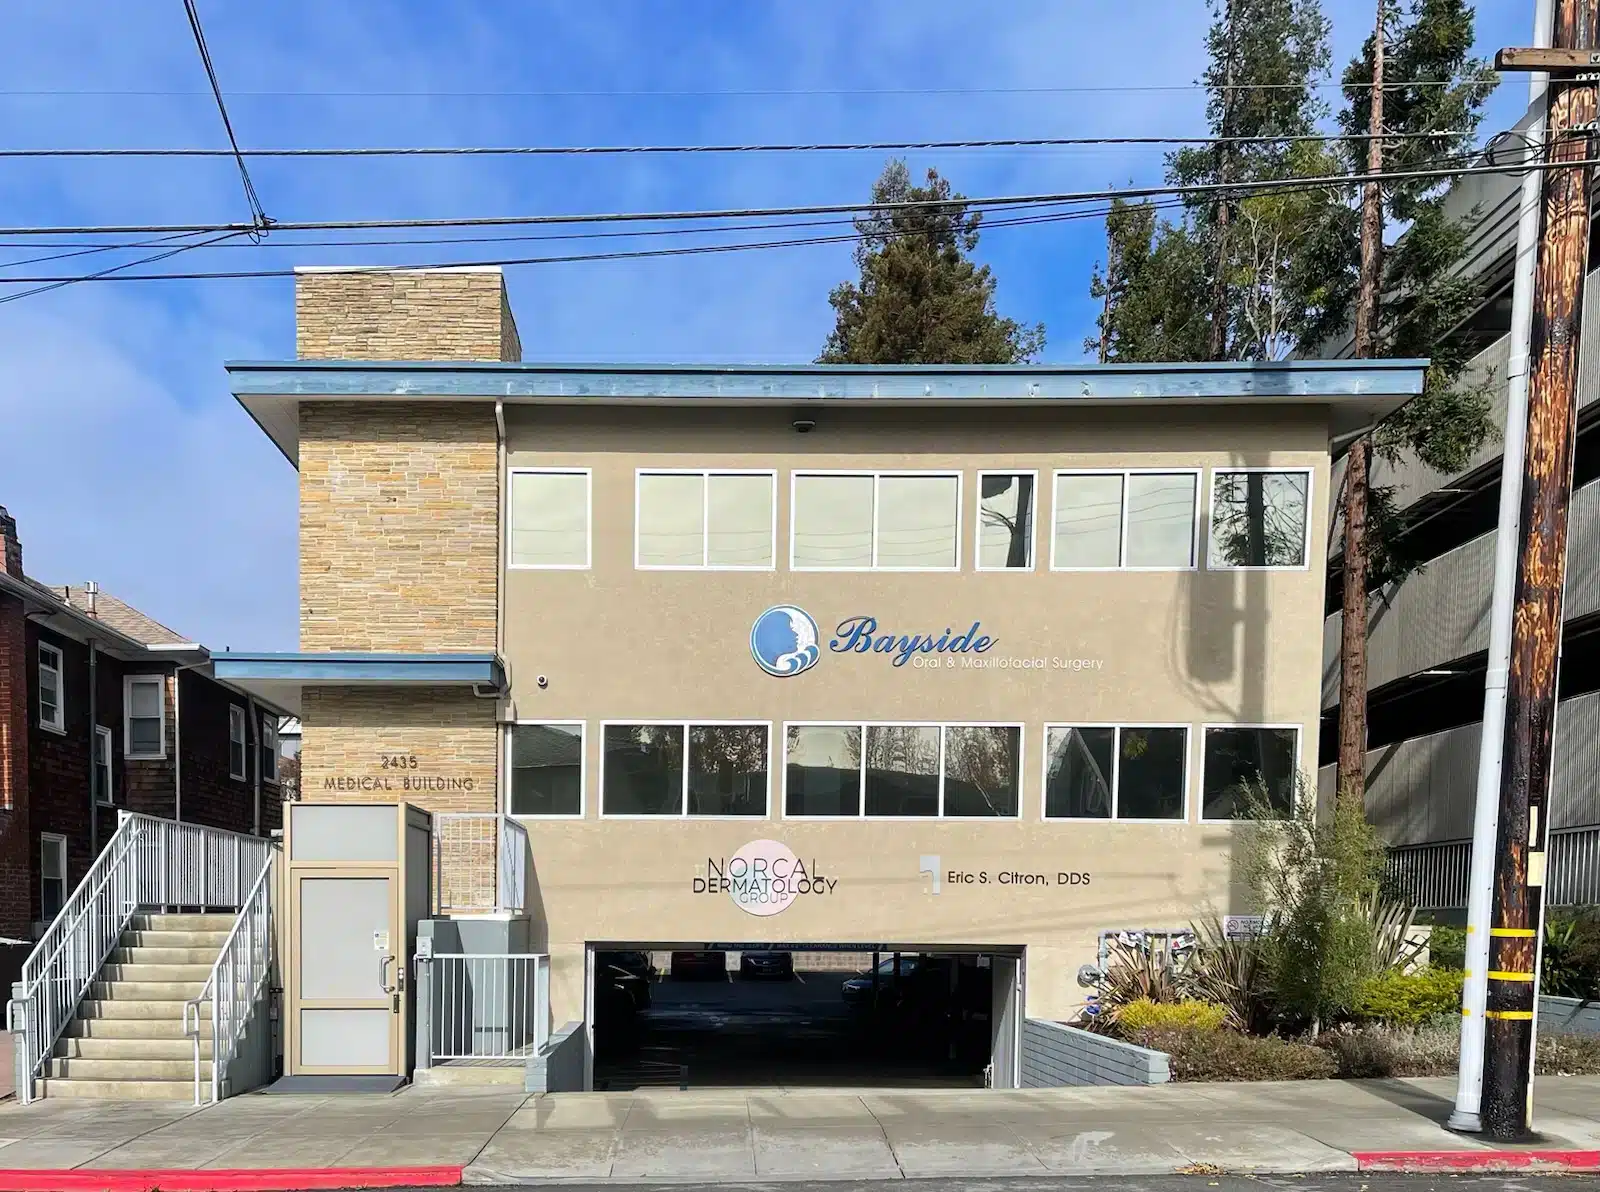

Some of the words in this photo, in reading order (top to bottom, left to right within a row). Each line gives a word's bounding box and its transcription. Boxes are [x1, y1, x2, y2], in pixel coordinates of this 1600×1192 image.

[829, 615, 999, 668] Bayside
[912, 655, 942, 669] Oral
[945, 656, 956, 669] &
[961, 655, 1048, 669] Maxillofacial
[1052, 656, 1104, 672] Surgery
[380, 755, 418, 770] 2435
[323, 776, 393, 791] MEDICAL
[403, 776, 474, 791] BUILDING
[707, 857, 825, 880] NORCAL
[692, 877, 838, 895] DERMATOLOGY
[947, 871, 975, 884] Eric
[978, 871, 992, 884] S.
[998, 871, 1050, 886] Citron,
[1057, 872, 1091, 885] DDS
[739, 892, 789, 904] GROUP
